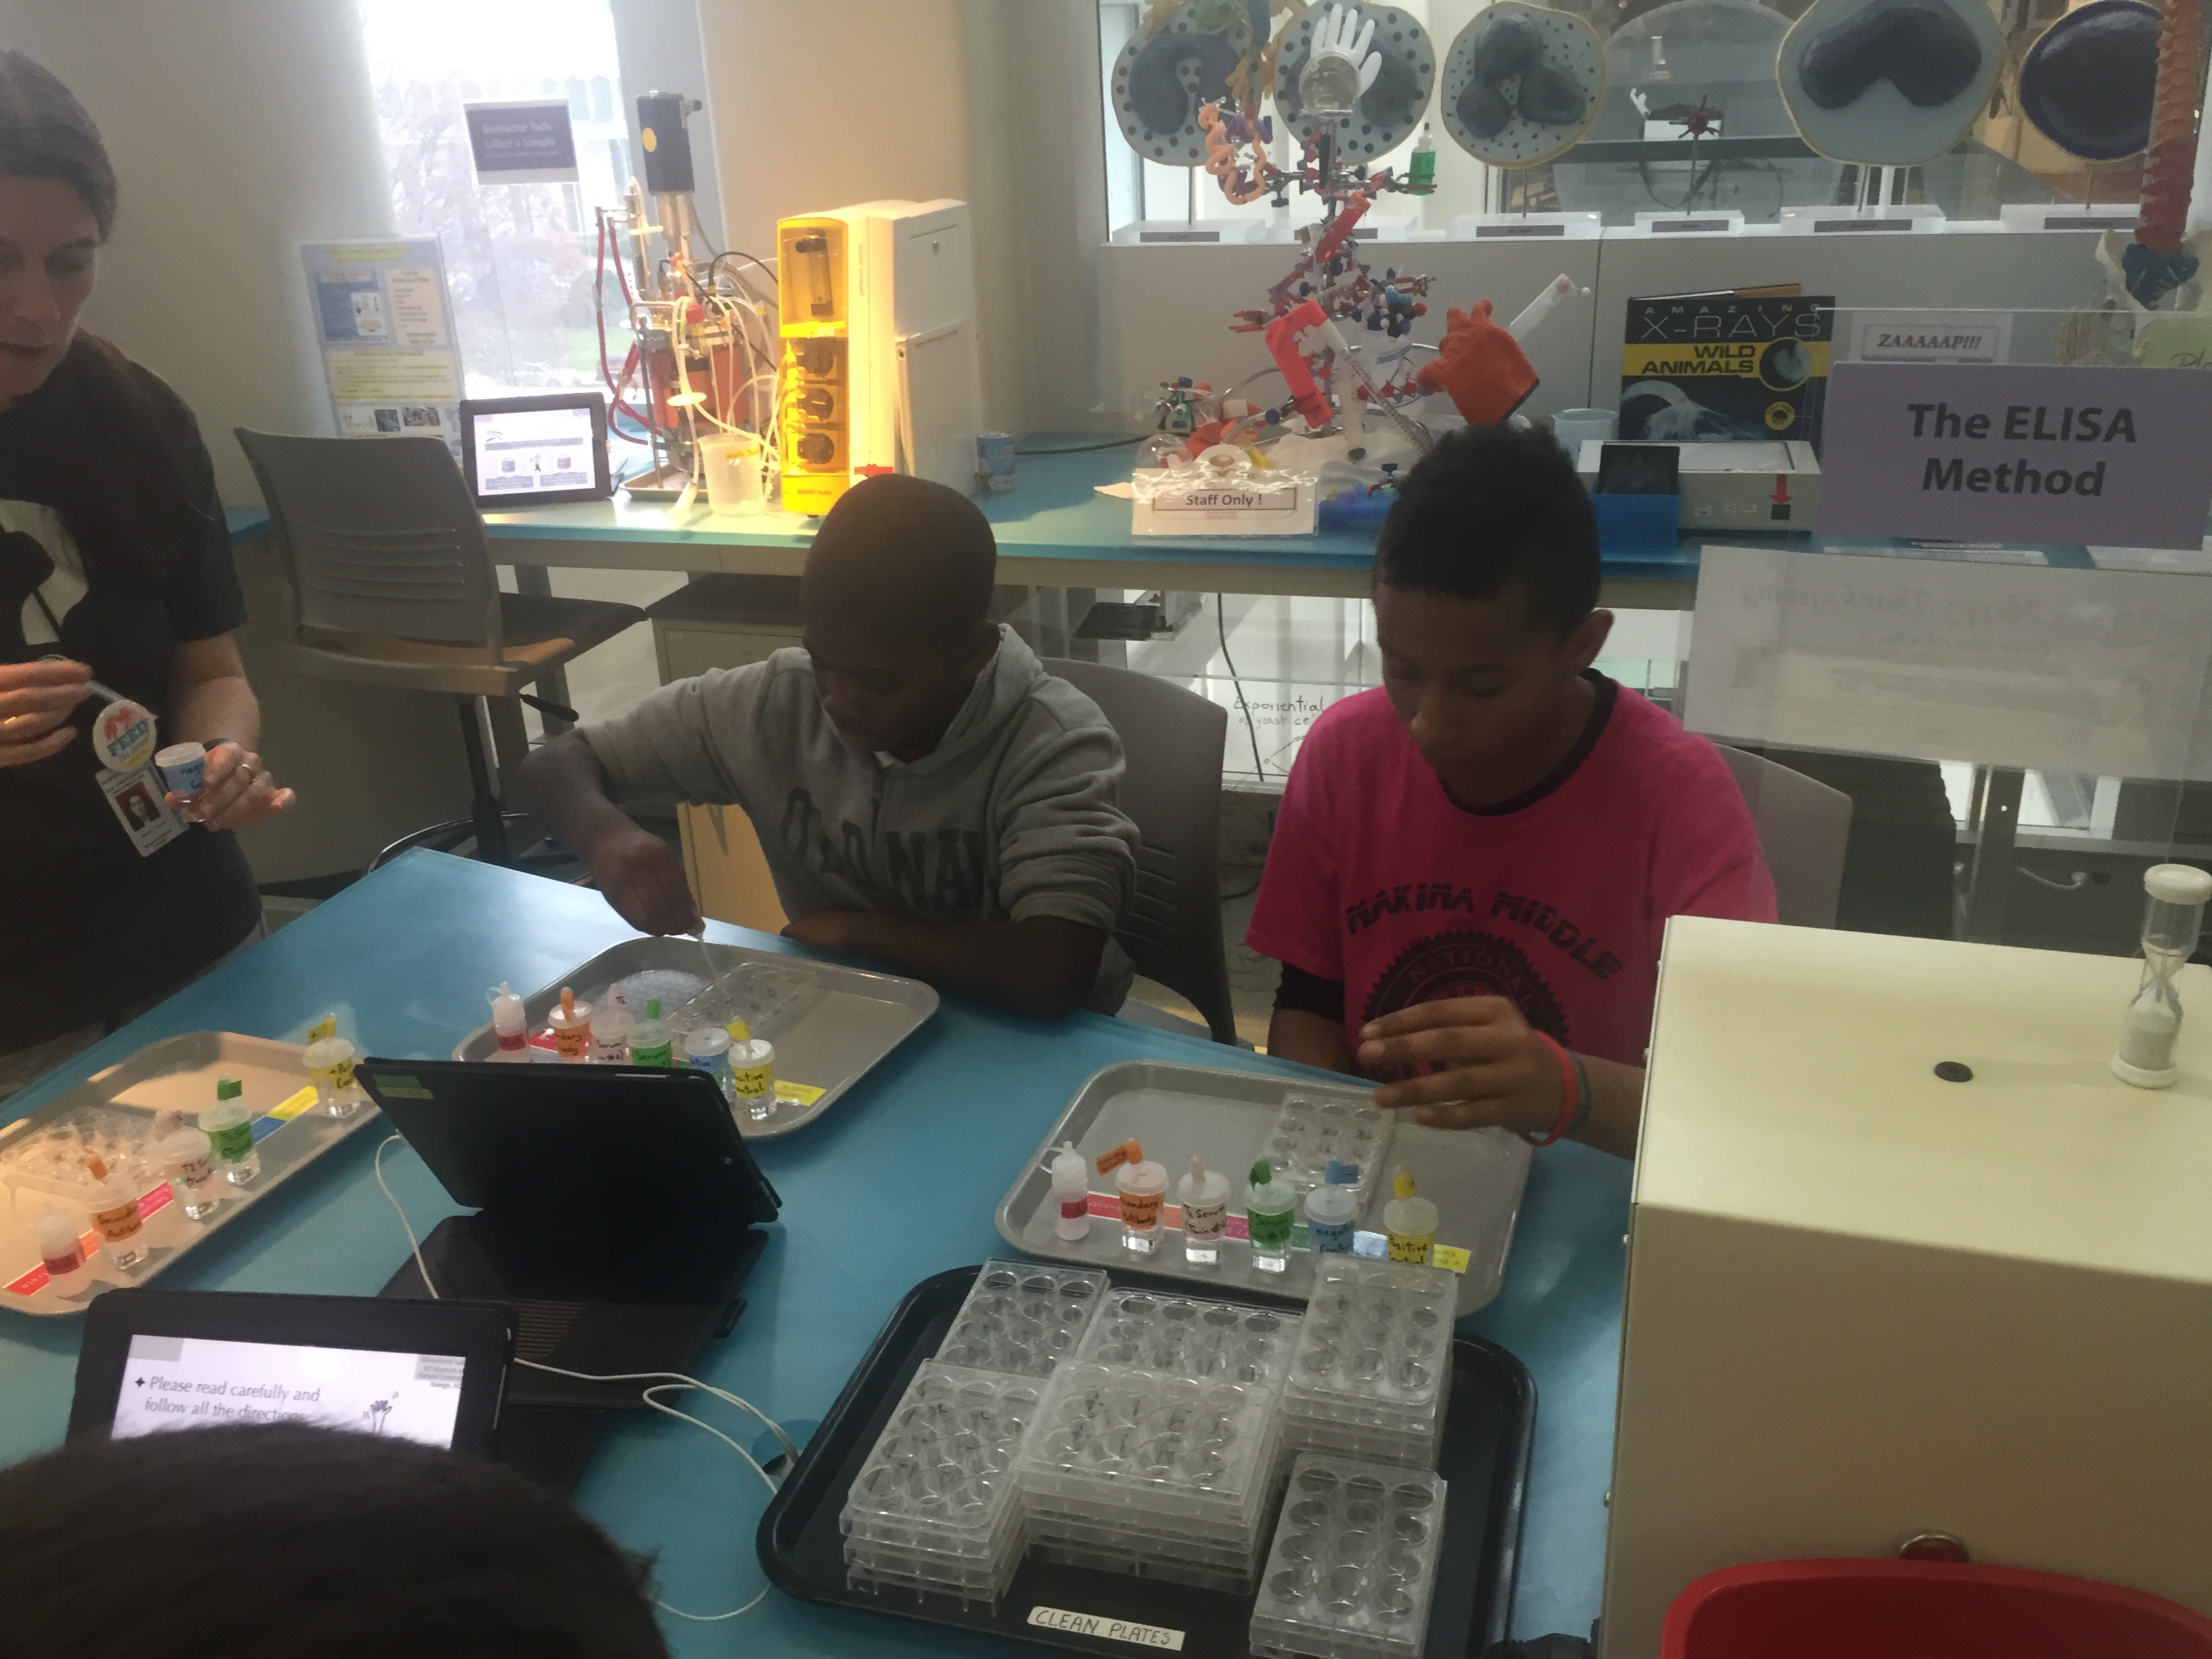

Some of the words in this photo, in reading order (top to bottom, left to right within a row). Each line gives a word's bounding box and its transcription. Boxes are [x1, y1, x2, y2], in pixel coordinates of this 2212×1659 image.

[1641, 312, 1822, 339] X-RAYS
[1694, 345, 1756, 359] WILD
[1641, 360, 1754, 374] ANIMALS
[1907, 403, 1991, 439] The
[2003, 405, 2137, 443] ELISA
[1922, 457, 2106, 497] Method
[1186, 493, 1218, 506] Staff
[1221, 495, 1254, 507] Only
[1234, 695, 1324, 716] Exponential
[1256, 716, 1287, 730] yeast
[106, 720, 149, 757] FEED
[1489, 890, 1624, 981] MIDDLE
[736, 1084, 764, 1094] ontrol
[149, 1376, 192, 1392] Please
[196, 1381, 227, 1395] read
[230, 1384, 289, 1403] carefully
[293, 1388, 321, 1402] and
[145, 1397, 187, 1414] follow
[191, 1401, 209, 1416] all
[213, 1403, 234, 1418] the
[1035, 1610, 1100, 1635] CLEAN
[1109, 1622, 1171, 1646] PLATES
